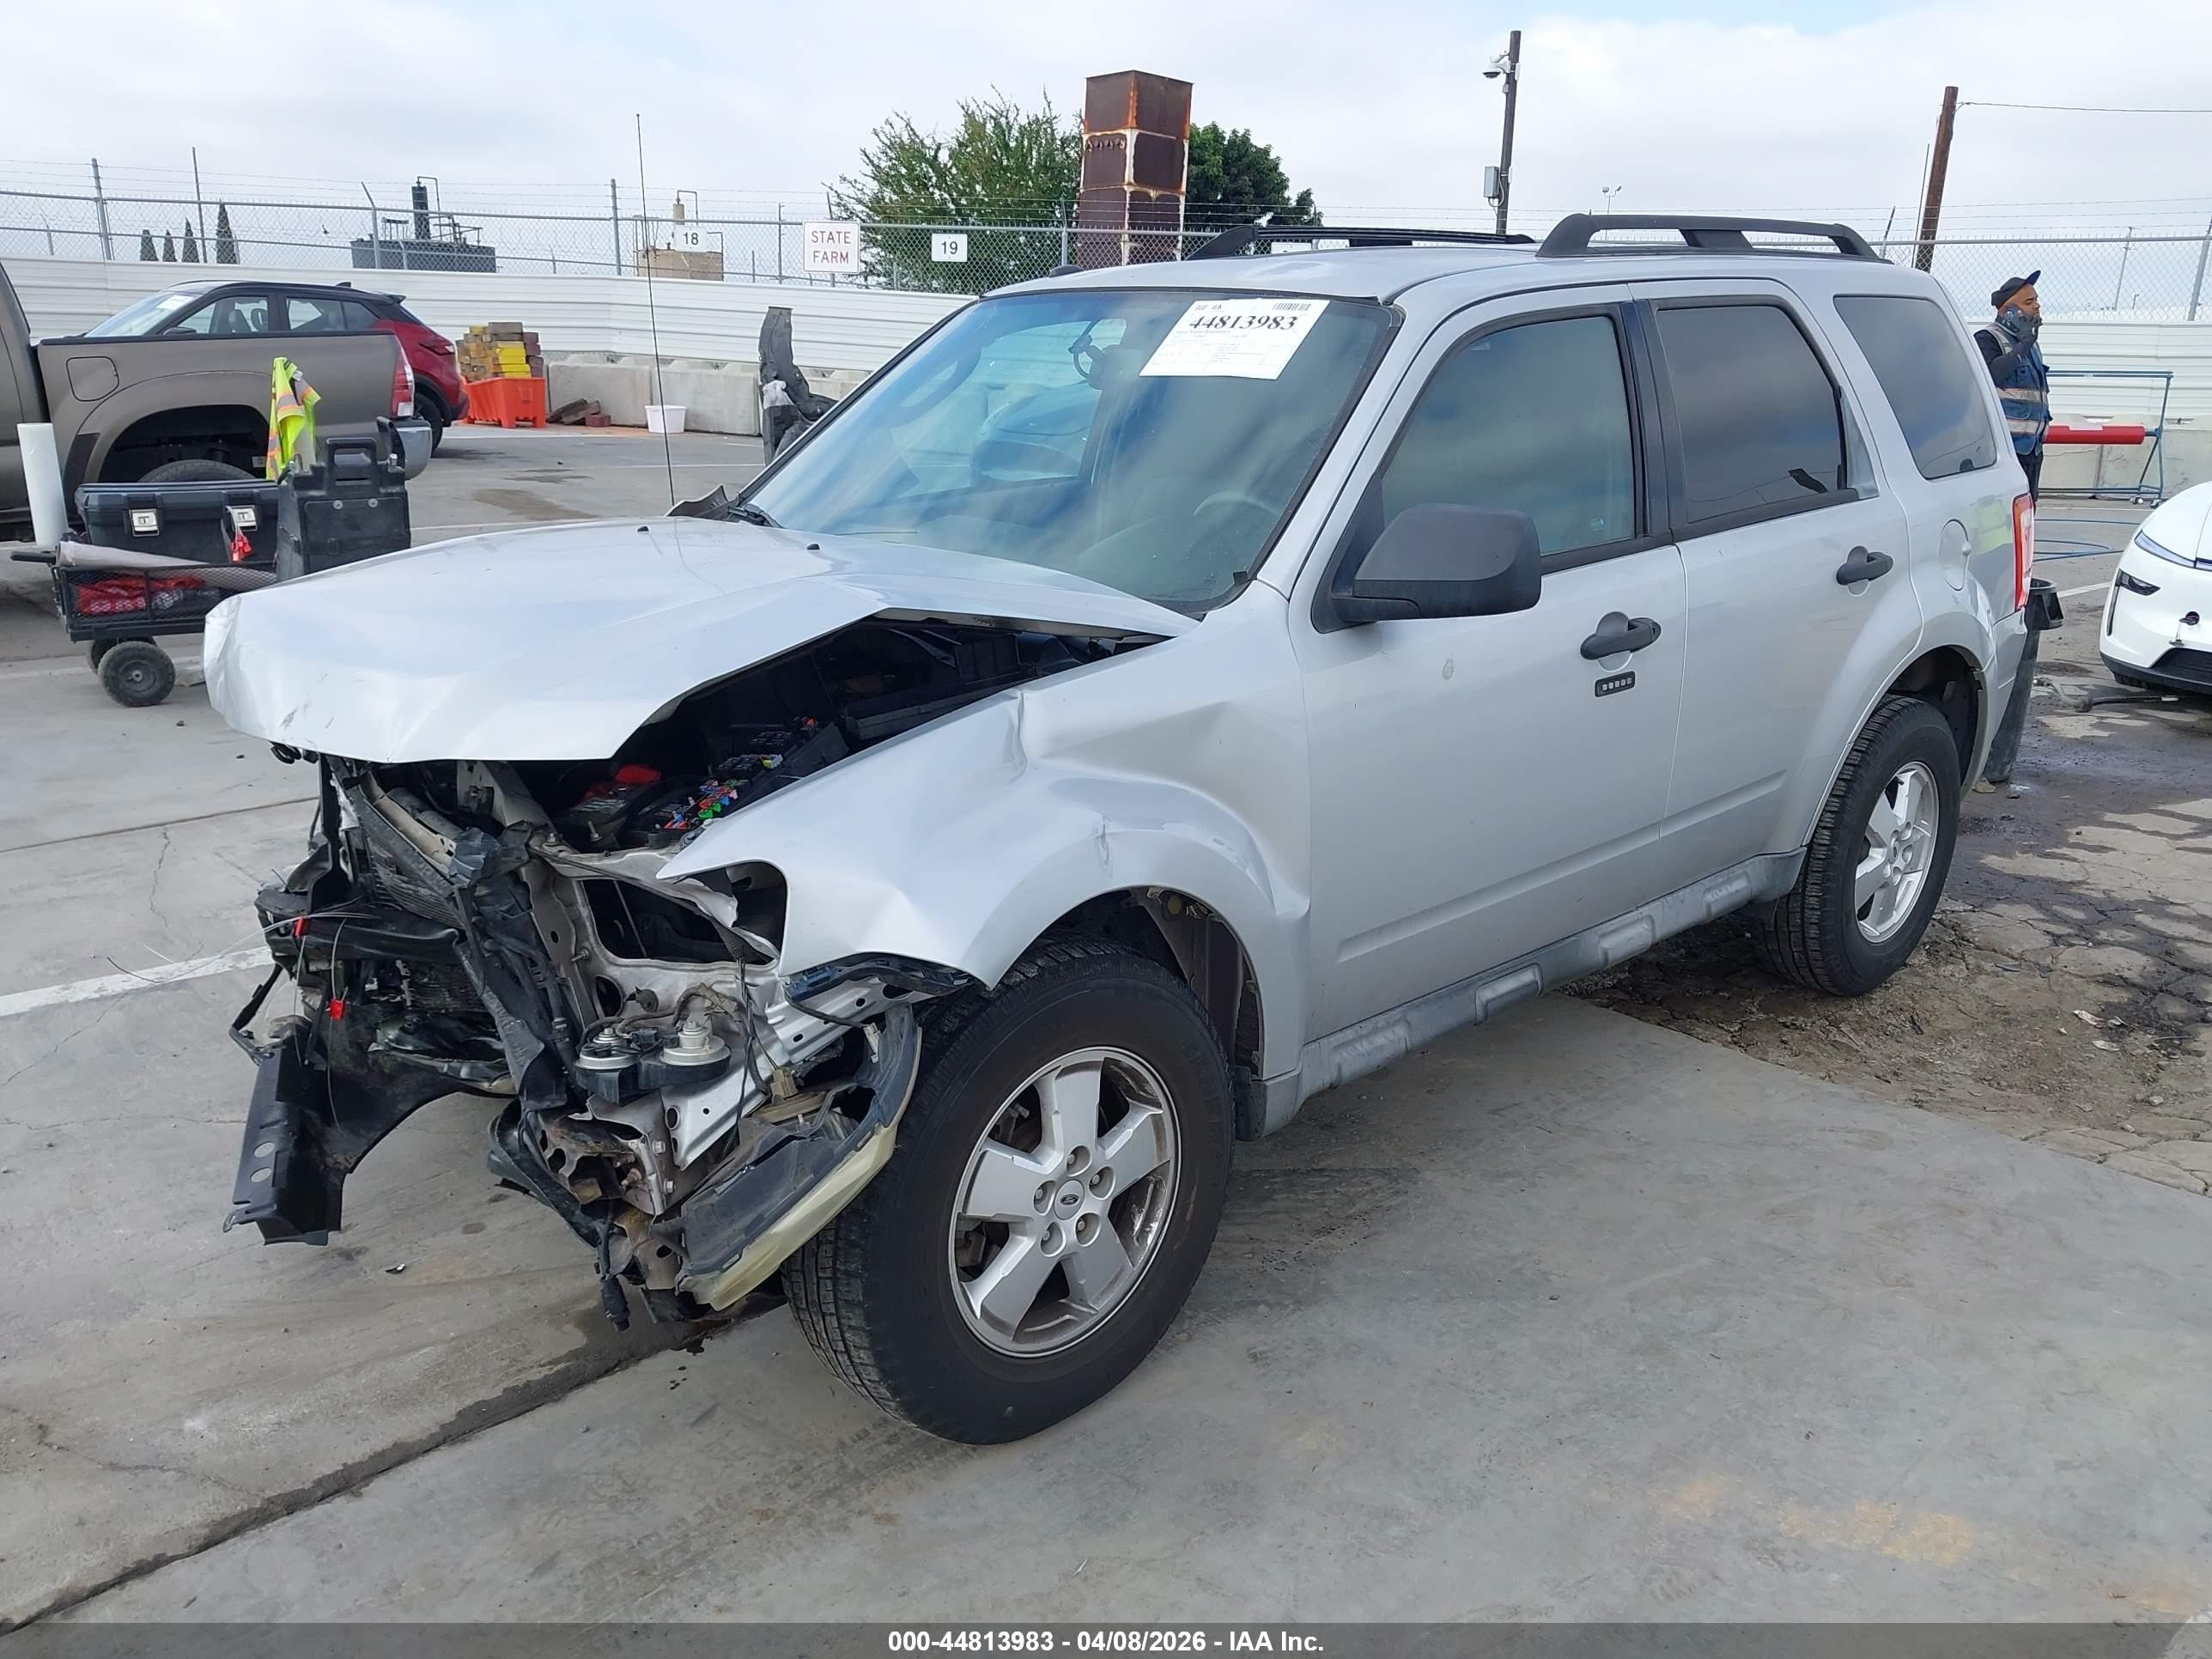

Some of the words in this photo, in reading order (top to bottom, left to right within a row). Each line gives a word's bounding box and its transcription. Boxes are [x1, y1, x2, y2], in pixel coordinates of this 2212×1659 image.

[684, 232, 698, 245] 18
[811, 230, 851, 244] STATE
[941, 240, 958, 255] 19
[812, 251, 848, 264] FARM
[1189, 314, 1297, 331] 44813983
